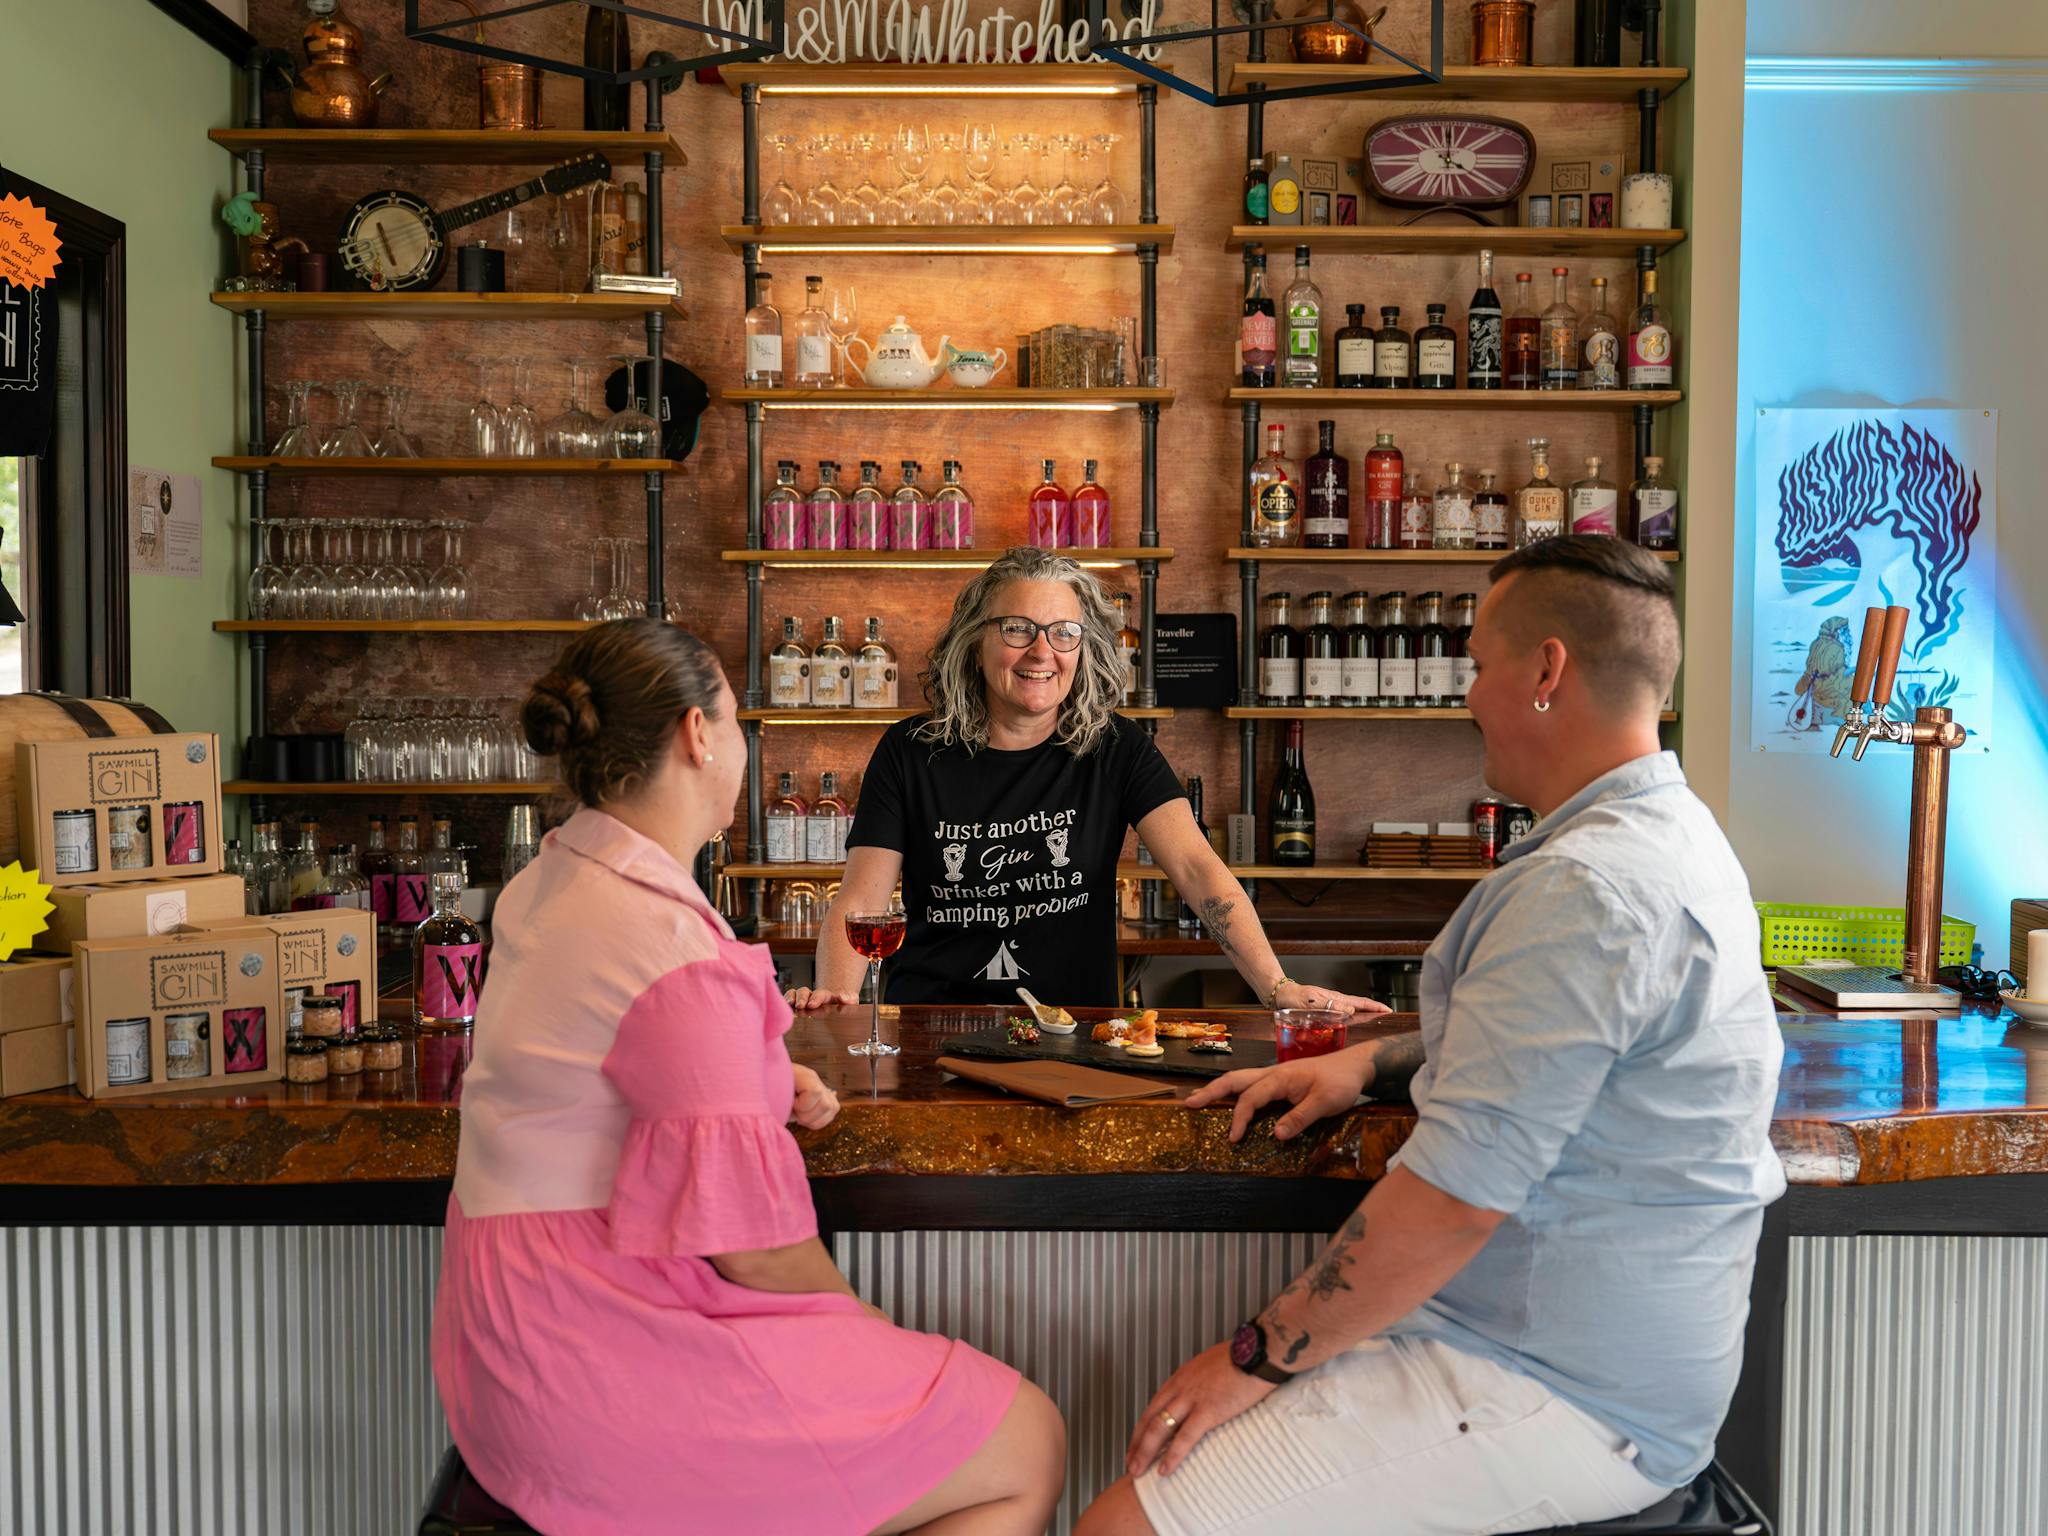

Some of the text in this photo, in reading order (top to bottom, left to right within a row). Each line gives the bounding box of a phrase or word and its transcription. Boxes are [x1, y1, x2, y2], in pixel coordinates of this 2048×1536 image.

[1306, 170, 1334, 187] GIN
[1556, 173, 1587, 189] GIN
[19, 231, 47, 257] Bags
[11, 249, 33, 266] each
[878, 348, 911, 360] GIN
[1261, 497, 1296, 509] OPIHR
[1534, 504, 1551, 513] GIN
[1155, 628, 1196, 638] Traveller
[98, 758, 153, 770] SAWMILL
[97, 769, 153, 796] GIN
[934, 809, 1077, 841] Just another
[979, 844, 1036, 881] Gin
[930, 870, 1083, 901] Drinker with a
[926, 892, 1090, 929] Camping problem
[160, 961, 218, 974] SAWMILL
[159, 971, 218, 1001] GIN
